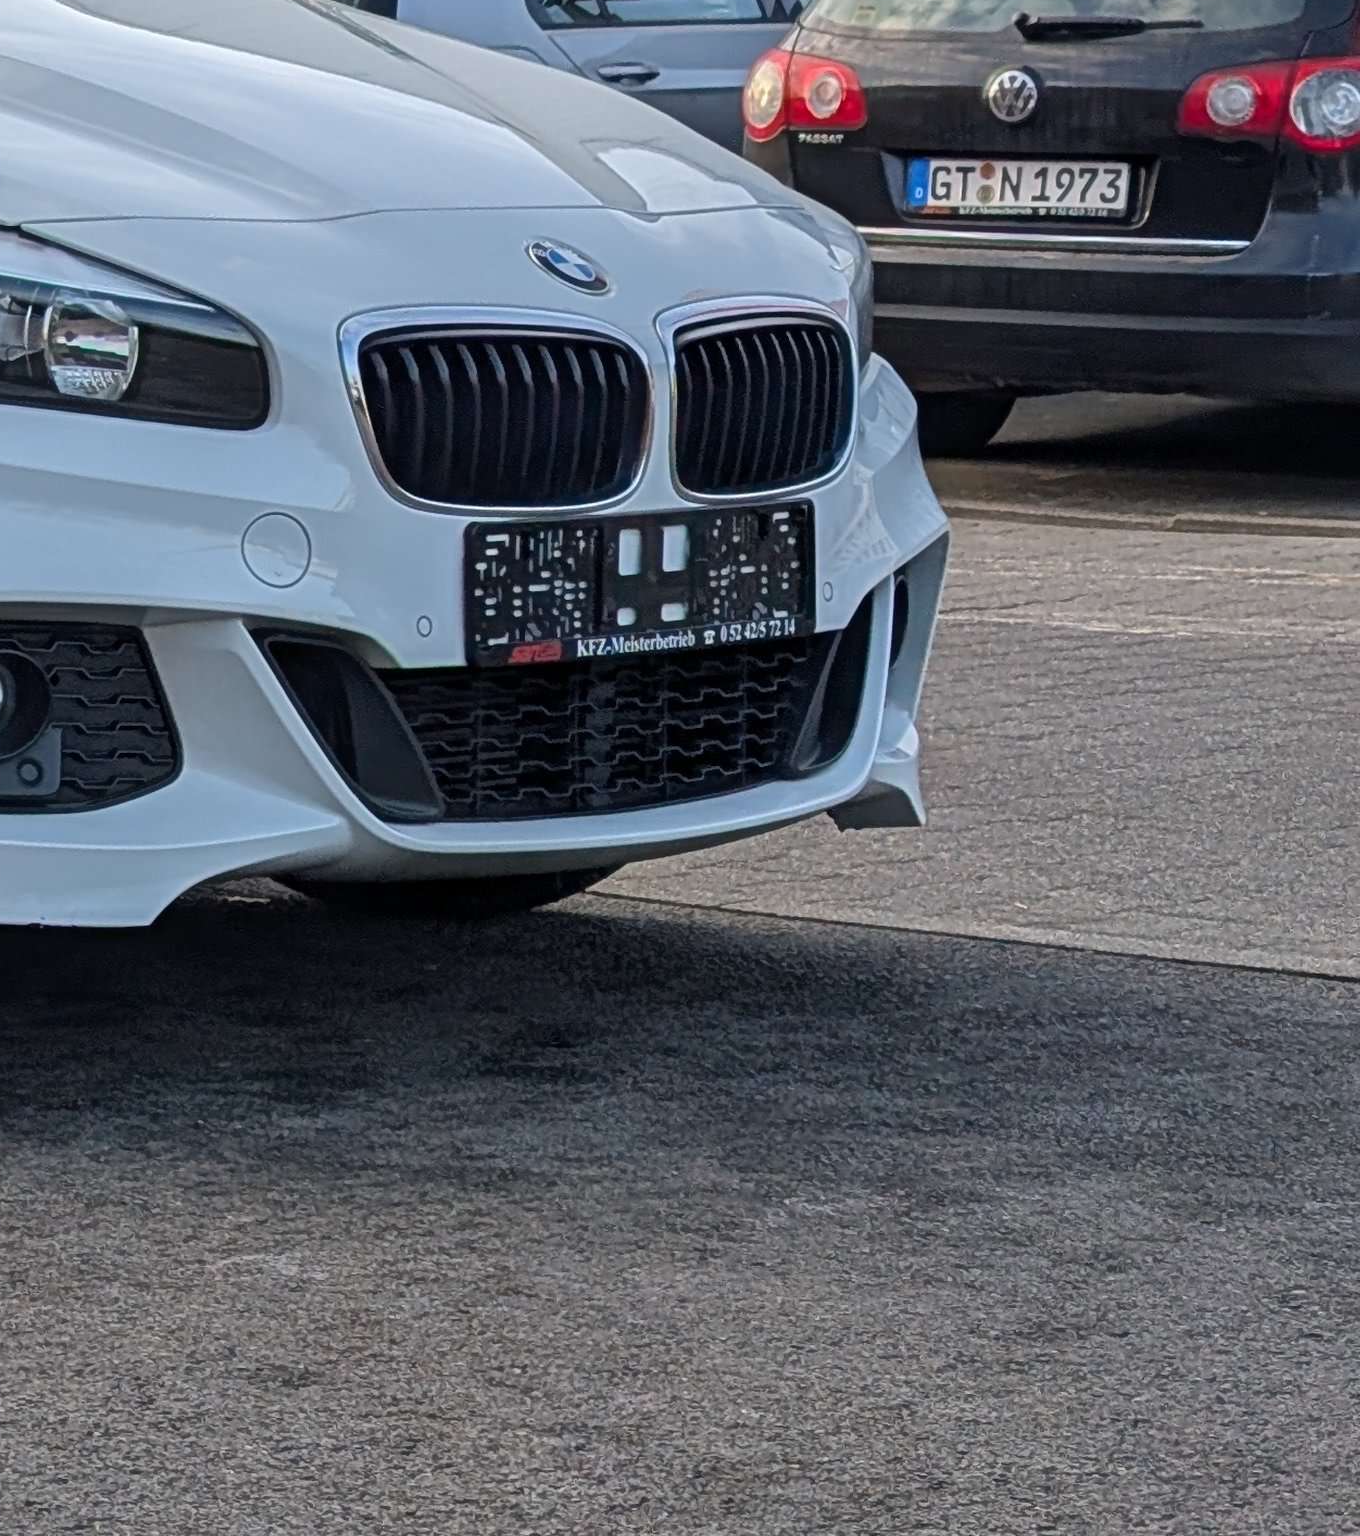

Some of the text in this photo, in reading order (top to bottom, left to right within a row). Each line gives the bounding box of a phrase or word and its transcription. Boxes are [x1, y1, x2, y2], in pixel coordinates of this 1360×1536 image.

[930, 166, 976, 202] GT
[1030, 166, 1123, 204] 1973
[576, 628, 696, 658] KFZ-Meisterbetrieb
